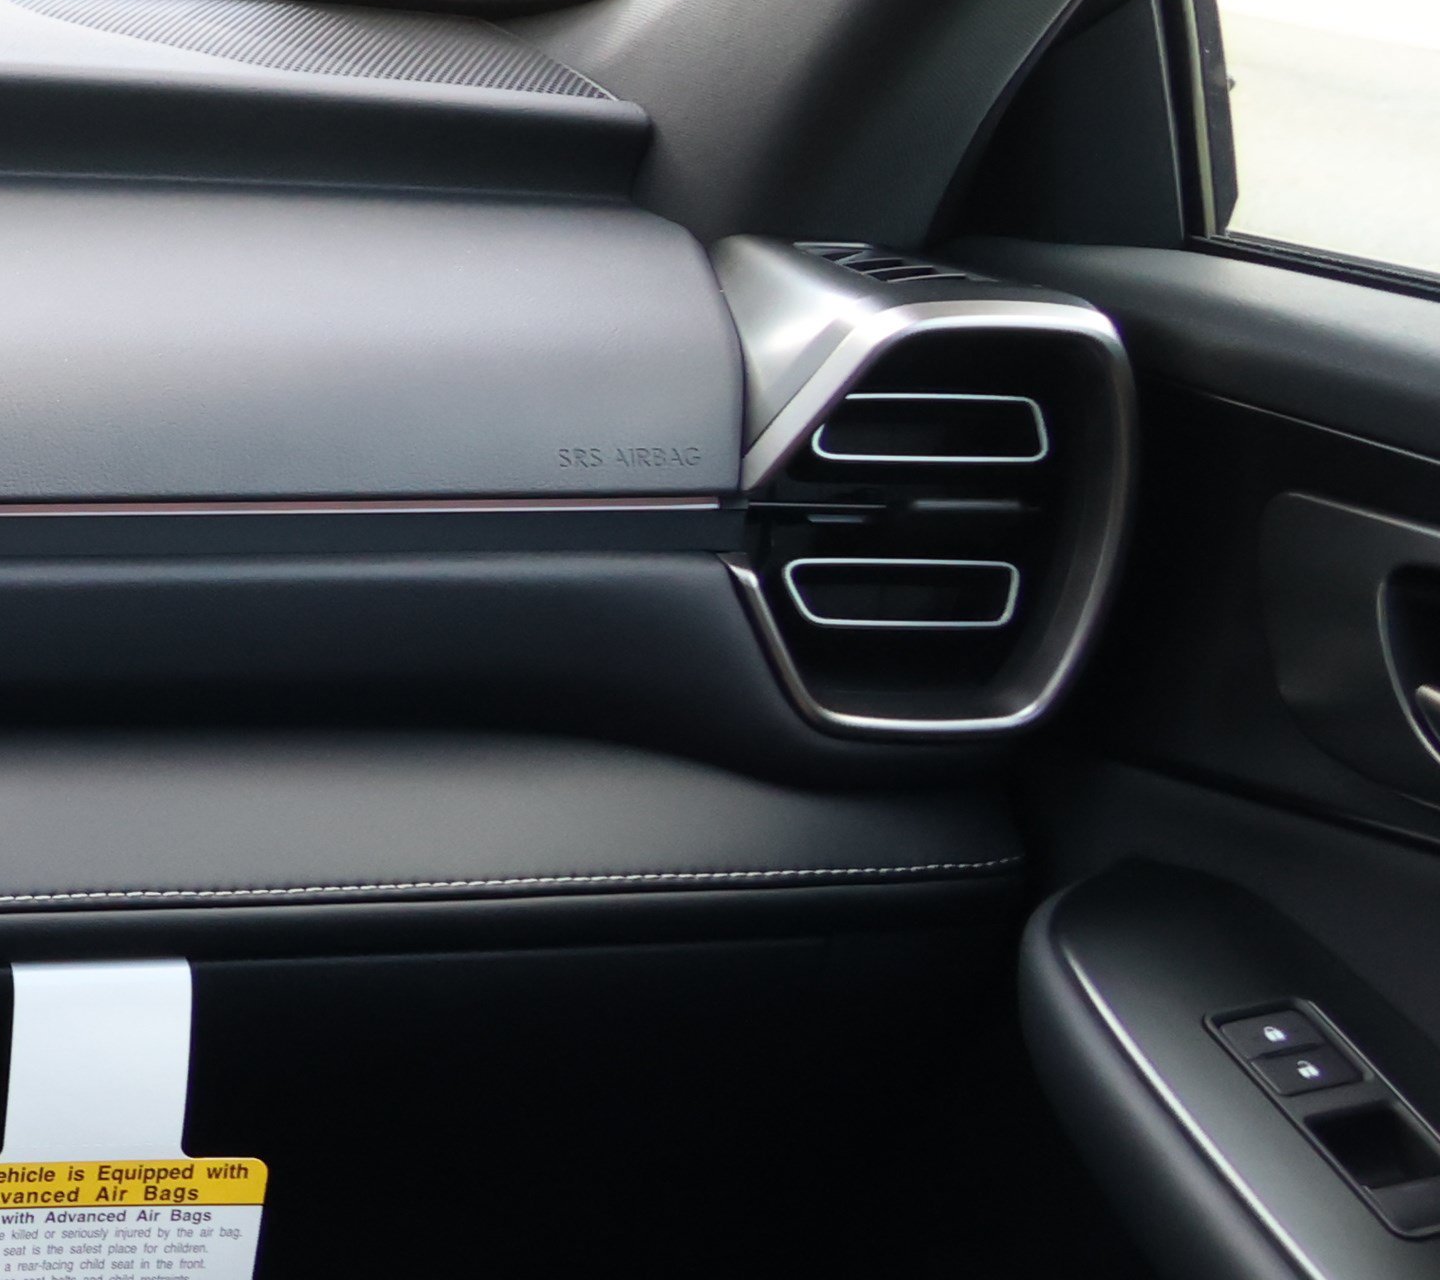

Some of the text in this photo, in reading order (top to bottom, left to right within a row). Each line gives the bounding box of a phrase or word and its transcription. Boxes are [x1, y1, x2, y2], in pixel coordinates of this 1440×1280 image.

[559, 447, 702, 469] SRS AIRBAG
[68, 1166, 85, 1181] is
[98, 1165, 194, 1184] Equipped
[207, 1164, 249, 1179] with
[95, 1186, 128, 1202] Air
[144, 1185, 199, 1202] Bags
[1, 1212, 34, 1224] with
[45, 1210, 126, 1223] Advanced
[136, 1210, 160, 1221] Air
[171, 1210, 212, 1224] Bags
[12, 1229, 38, 1240] killed
[61, 1228, 108, 1240] seriously
[115, 1227, 151, 1239] injured
[158, 1228, 169, 1239] by
[177, 1227, 192, 1237] the
[200, 1228, 213, 1237] air
[220, 1226, 242, 1239] bag.
[3, 1246, 26, 1256] seat
[32, 1246, 40, 1255] is
[47, 1245, 63, 1255] the
[69, 1244, 102, 1254] safest
[108, 1244, 137, 1256] place
[144, 1243, 157, 1253] for
[164, 1242, 208, 1253] children.
[18, 1260, 74, 1273] rear-facing
[80, 1259, 104, 1270] child
[111, 1260, 134, 1269] seat
[140, 1259, 150, 1269] in
[156, 1259, 173, 1269] the
[180, 1259, 205, 1269] front.
